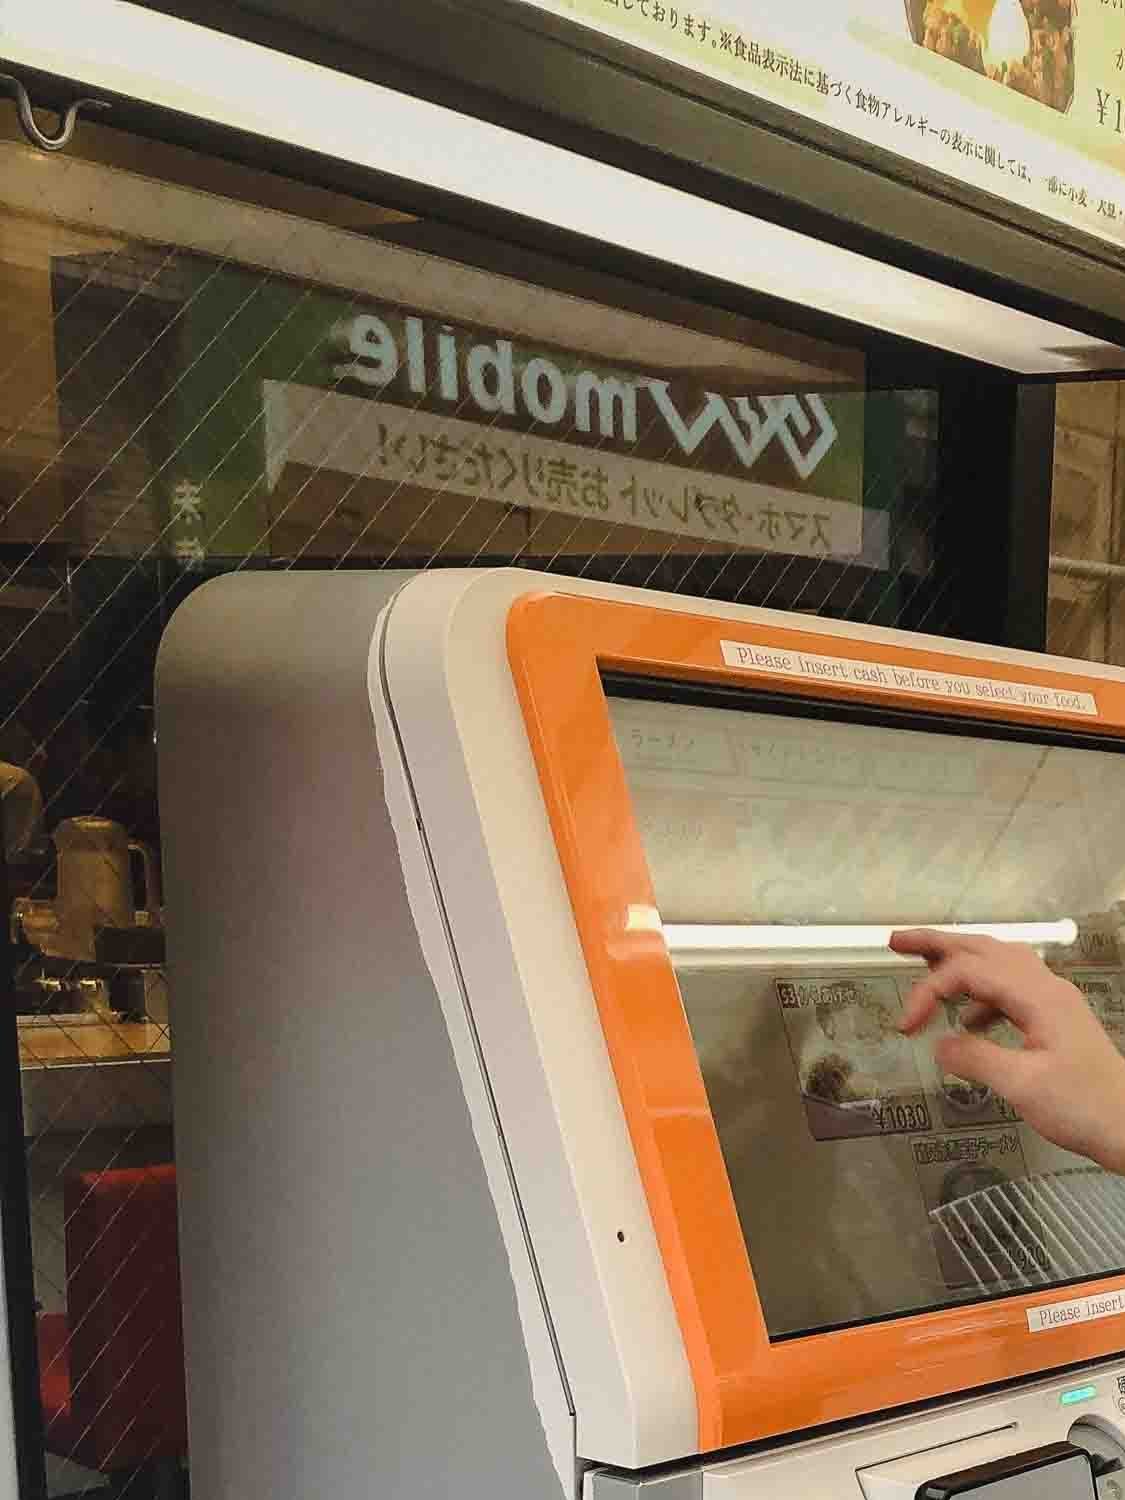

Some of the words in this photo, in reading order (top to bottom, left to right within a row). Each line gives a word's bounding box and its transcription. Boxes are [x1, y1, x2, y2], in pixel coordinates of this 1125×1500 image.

[736, 646, 793, 671] Please
[798, 655, 849, 680] insert
[853, 664, 889, 685] cash
[891, 668, 940, 690] before
[944, 679, 971, 696] you
[1039, 1306, 1081, 1326] Please
[1086, 1297, 1125, 1316] insert
